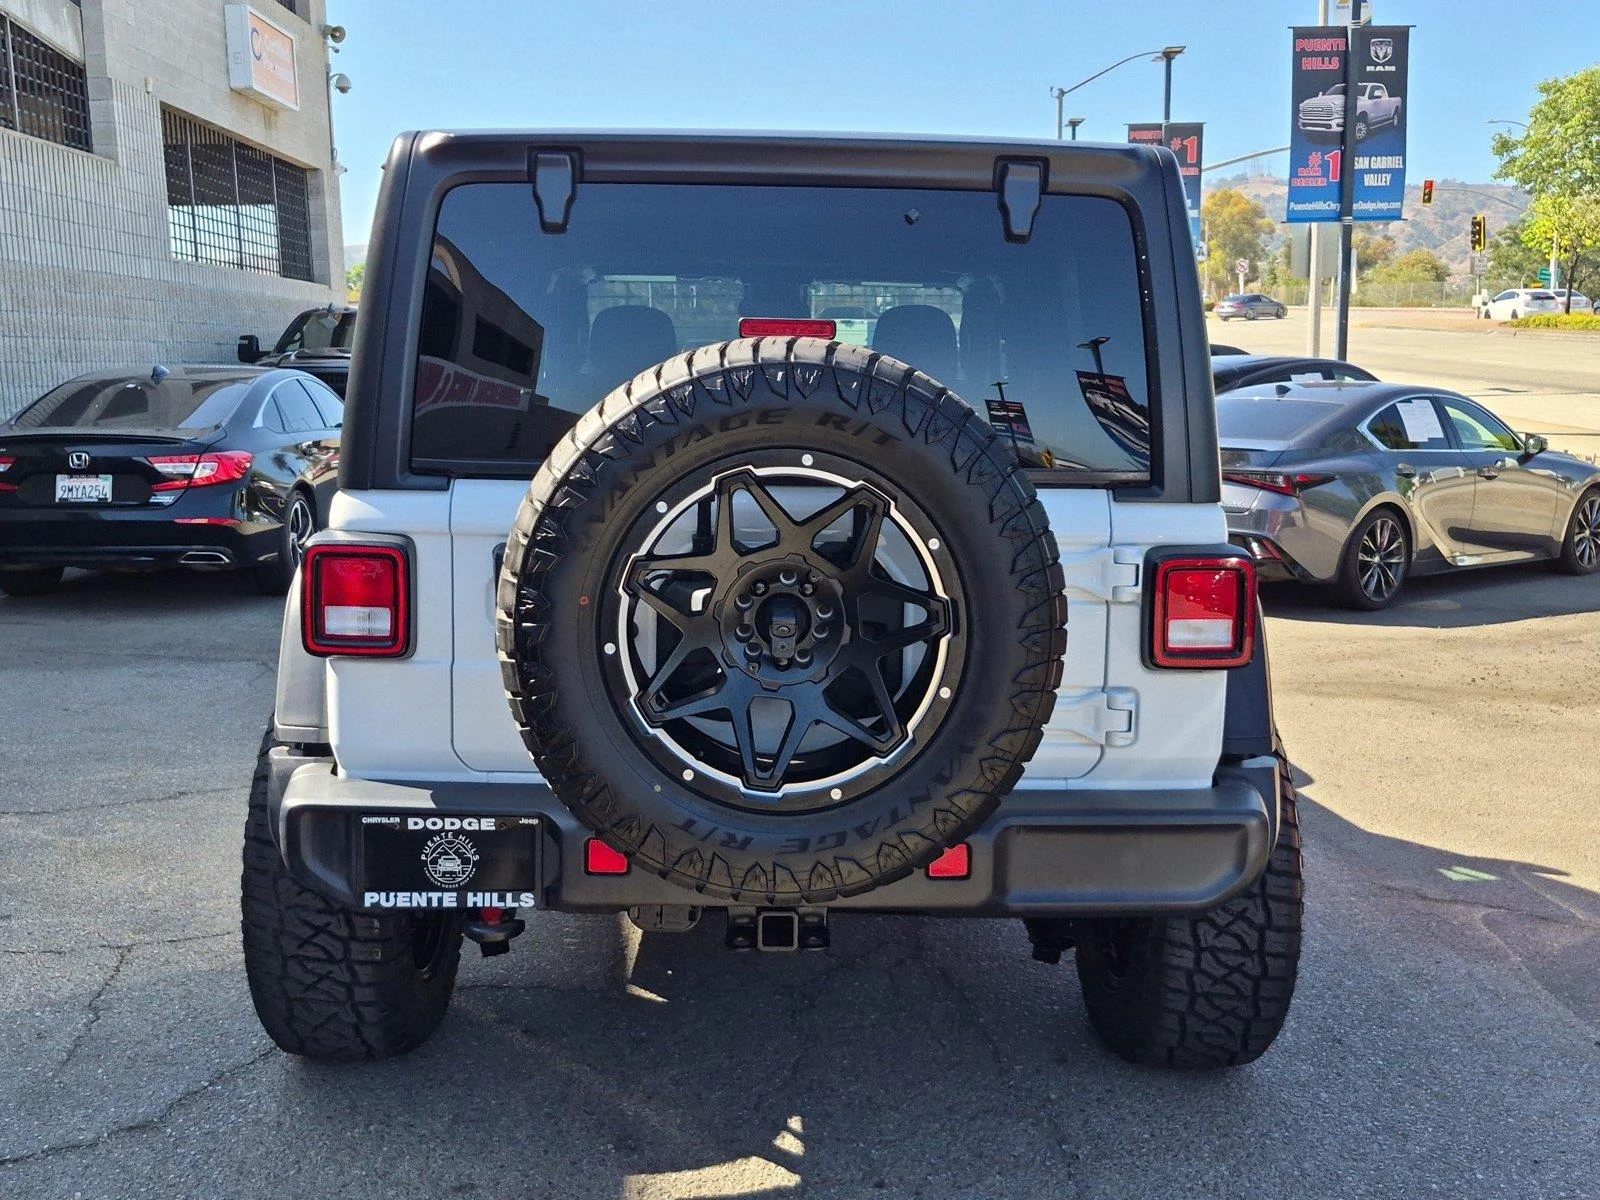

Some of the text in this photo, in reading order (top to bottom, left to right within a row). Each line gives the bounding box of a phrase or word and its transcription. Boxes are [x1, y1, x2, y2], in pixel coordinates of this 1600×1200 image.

[1295, 38, 1347, 52] PUENTE
[1302, 57, 1340, 70] HILLS
[1170, 135, 1198, 164] #1
[1308, 150, 1341, 182] #1
[1354, 156, 1404, 170] SAN GABRIEL
[1298, 167, 1322, 176] RAM
[1291, 177, 1327, 187] DEALER
[1364, 173, 1392, 187] VALLEY
[361, 816, 539, 831] CHRYSLER DODGE Jeep
[420, 831, 480, 861] PUENTE HILLS
[364, 891, 536, 908] PUENTE HILLS
